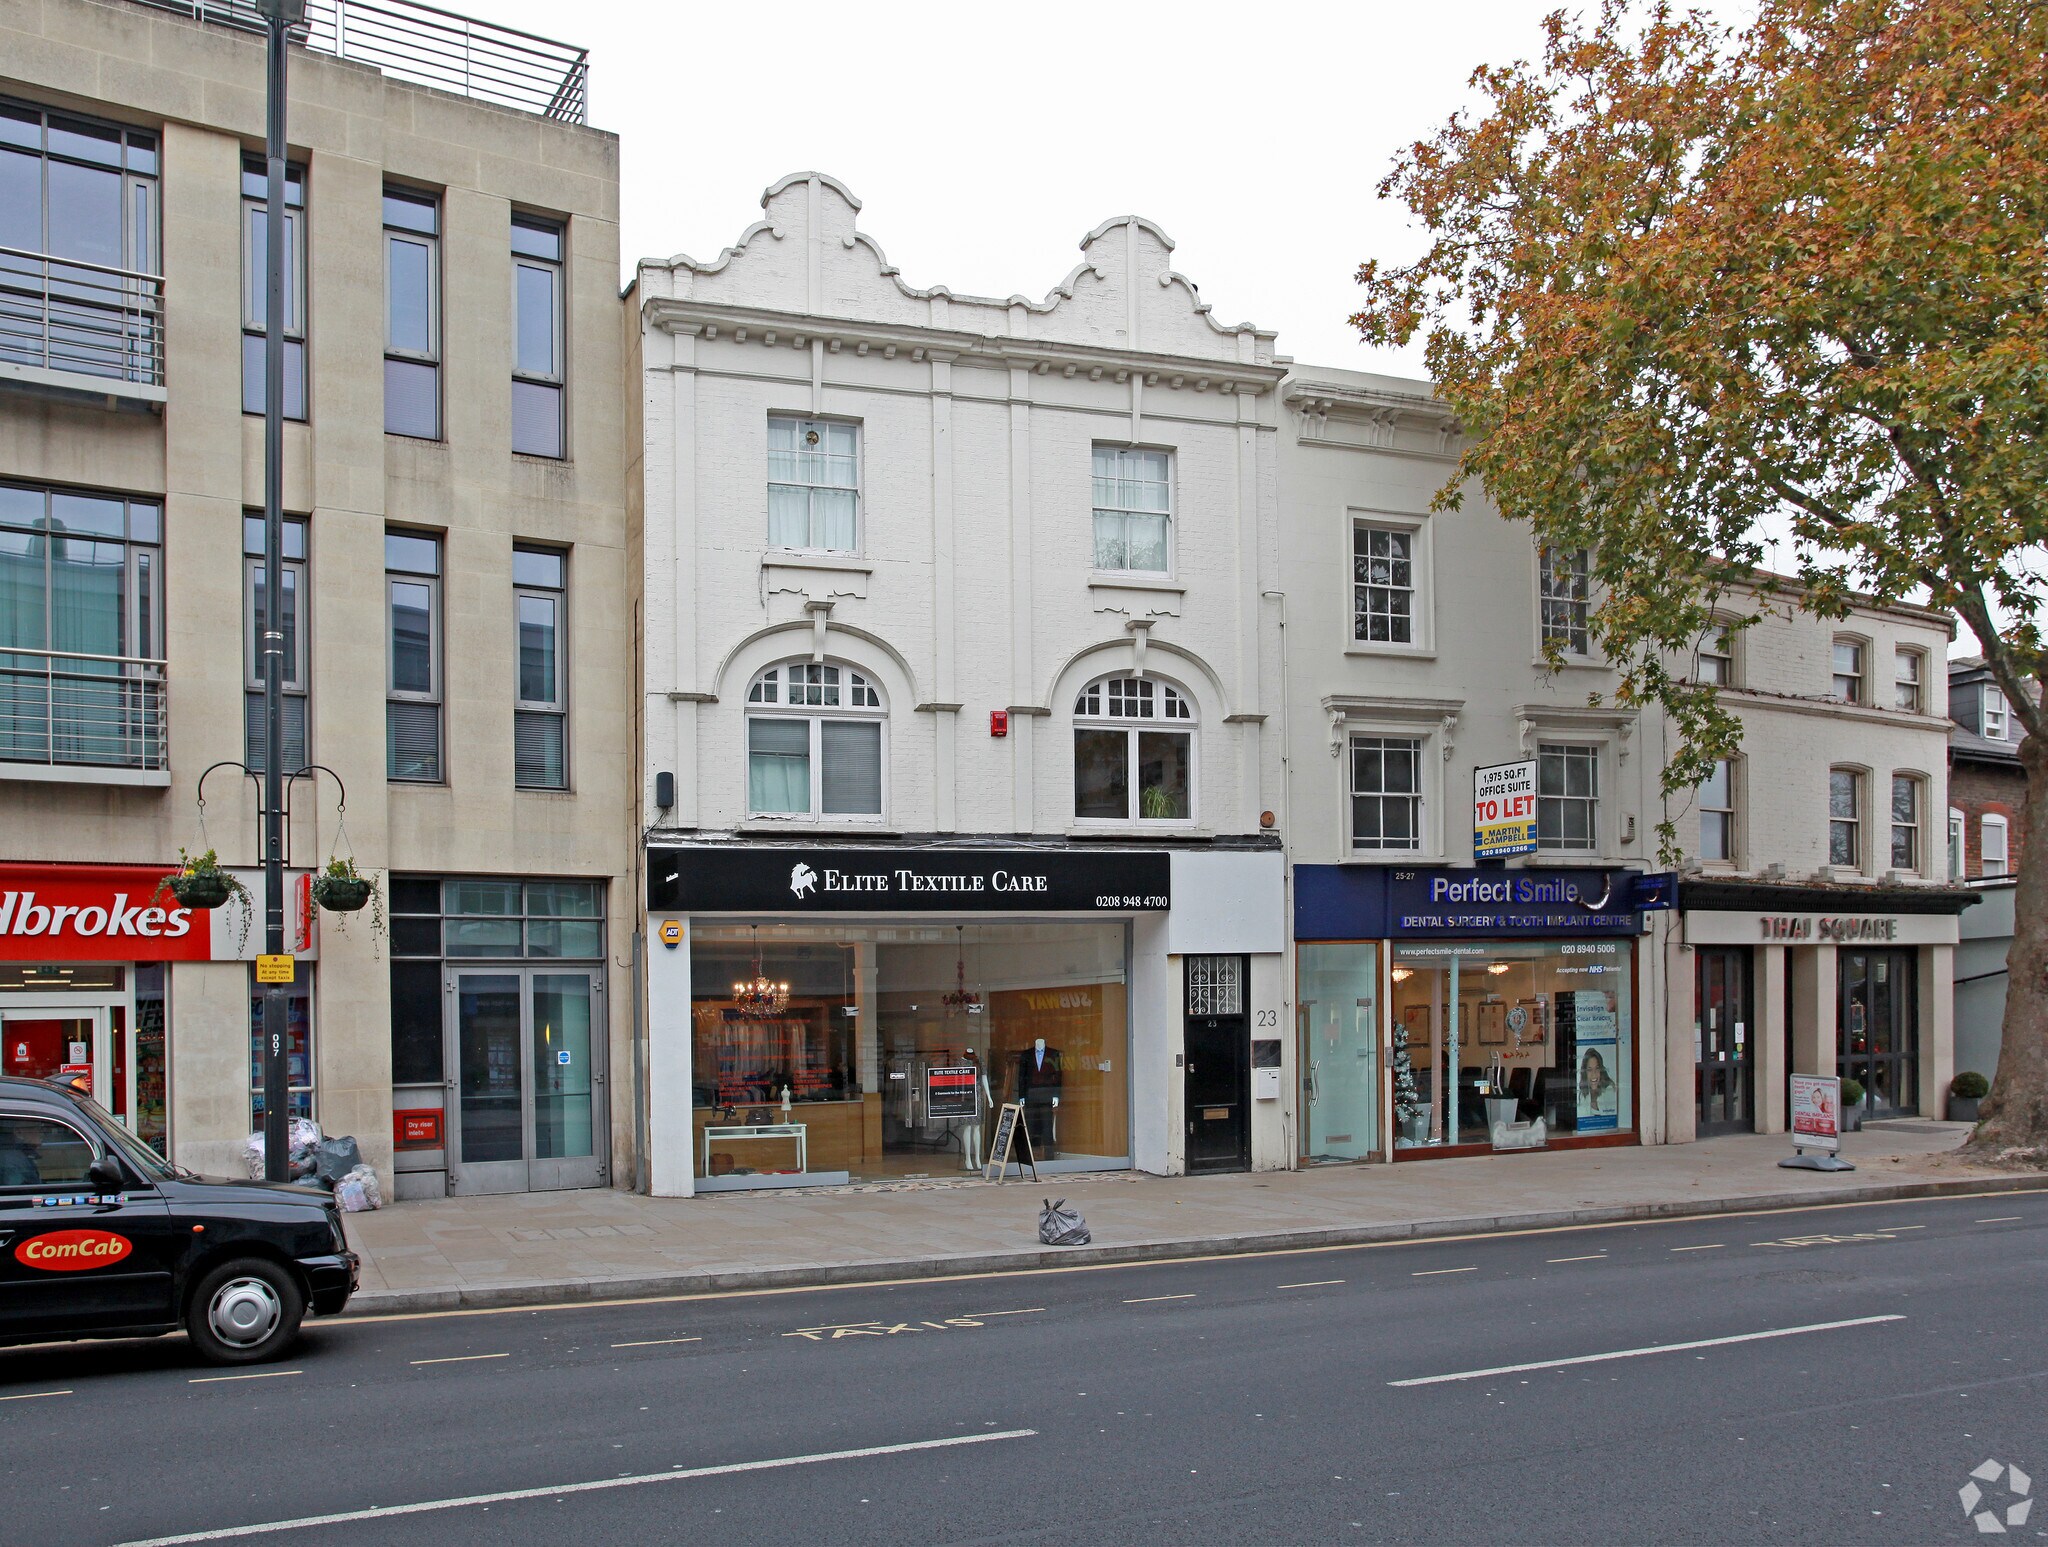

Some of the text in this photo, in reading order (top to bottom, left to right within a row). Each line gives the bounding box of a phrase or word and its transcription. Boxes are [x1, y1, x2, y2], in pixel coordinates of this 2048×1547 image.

[1483, 767, 1527, 784] 1,975 SQ.FT
[1479, 780, 1531, 797] OFFICE SUITE
[1476, 795, 1535, 821] TO LET
[1488, 826, 1521, 838] MARTIN
[1483, 833, 1526, 845] CAMPBELL
[1495, 847, 1511, 855] 8940
[1395, 872, 1415, 880] 25-27
[1432, 877, 1579, 903] Perfect Smile
[1096, 895, 1168, 907] 0208 948 4700
[1403, 915, 1632, 928] DENTAL SURGERY & TOOTH IMPLANT CENTRE
[666, 927, 679, 936] ADT
[1760, 916, 1897, 941] THAI SQUARE
[1399, 947, 1485, 957] www.perfectsmile-dental.com
[1561, 944, 1616, 954] 020 8940 5006
[1589, 965, 1603, 973] NHS
[1257, 1009, 1277, 1027] 23
[272, 1033, 280, 1057] 007
[408, 1121, 419, 1129] Dry
[26, 1237, 123, 1259] ComCab
[781, 1318, 985, 1341] TAXIS
